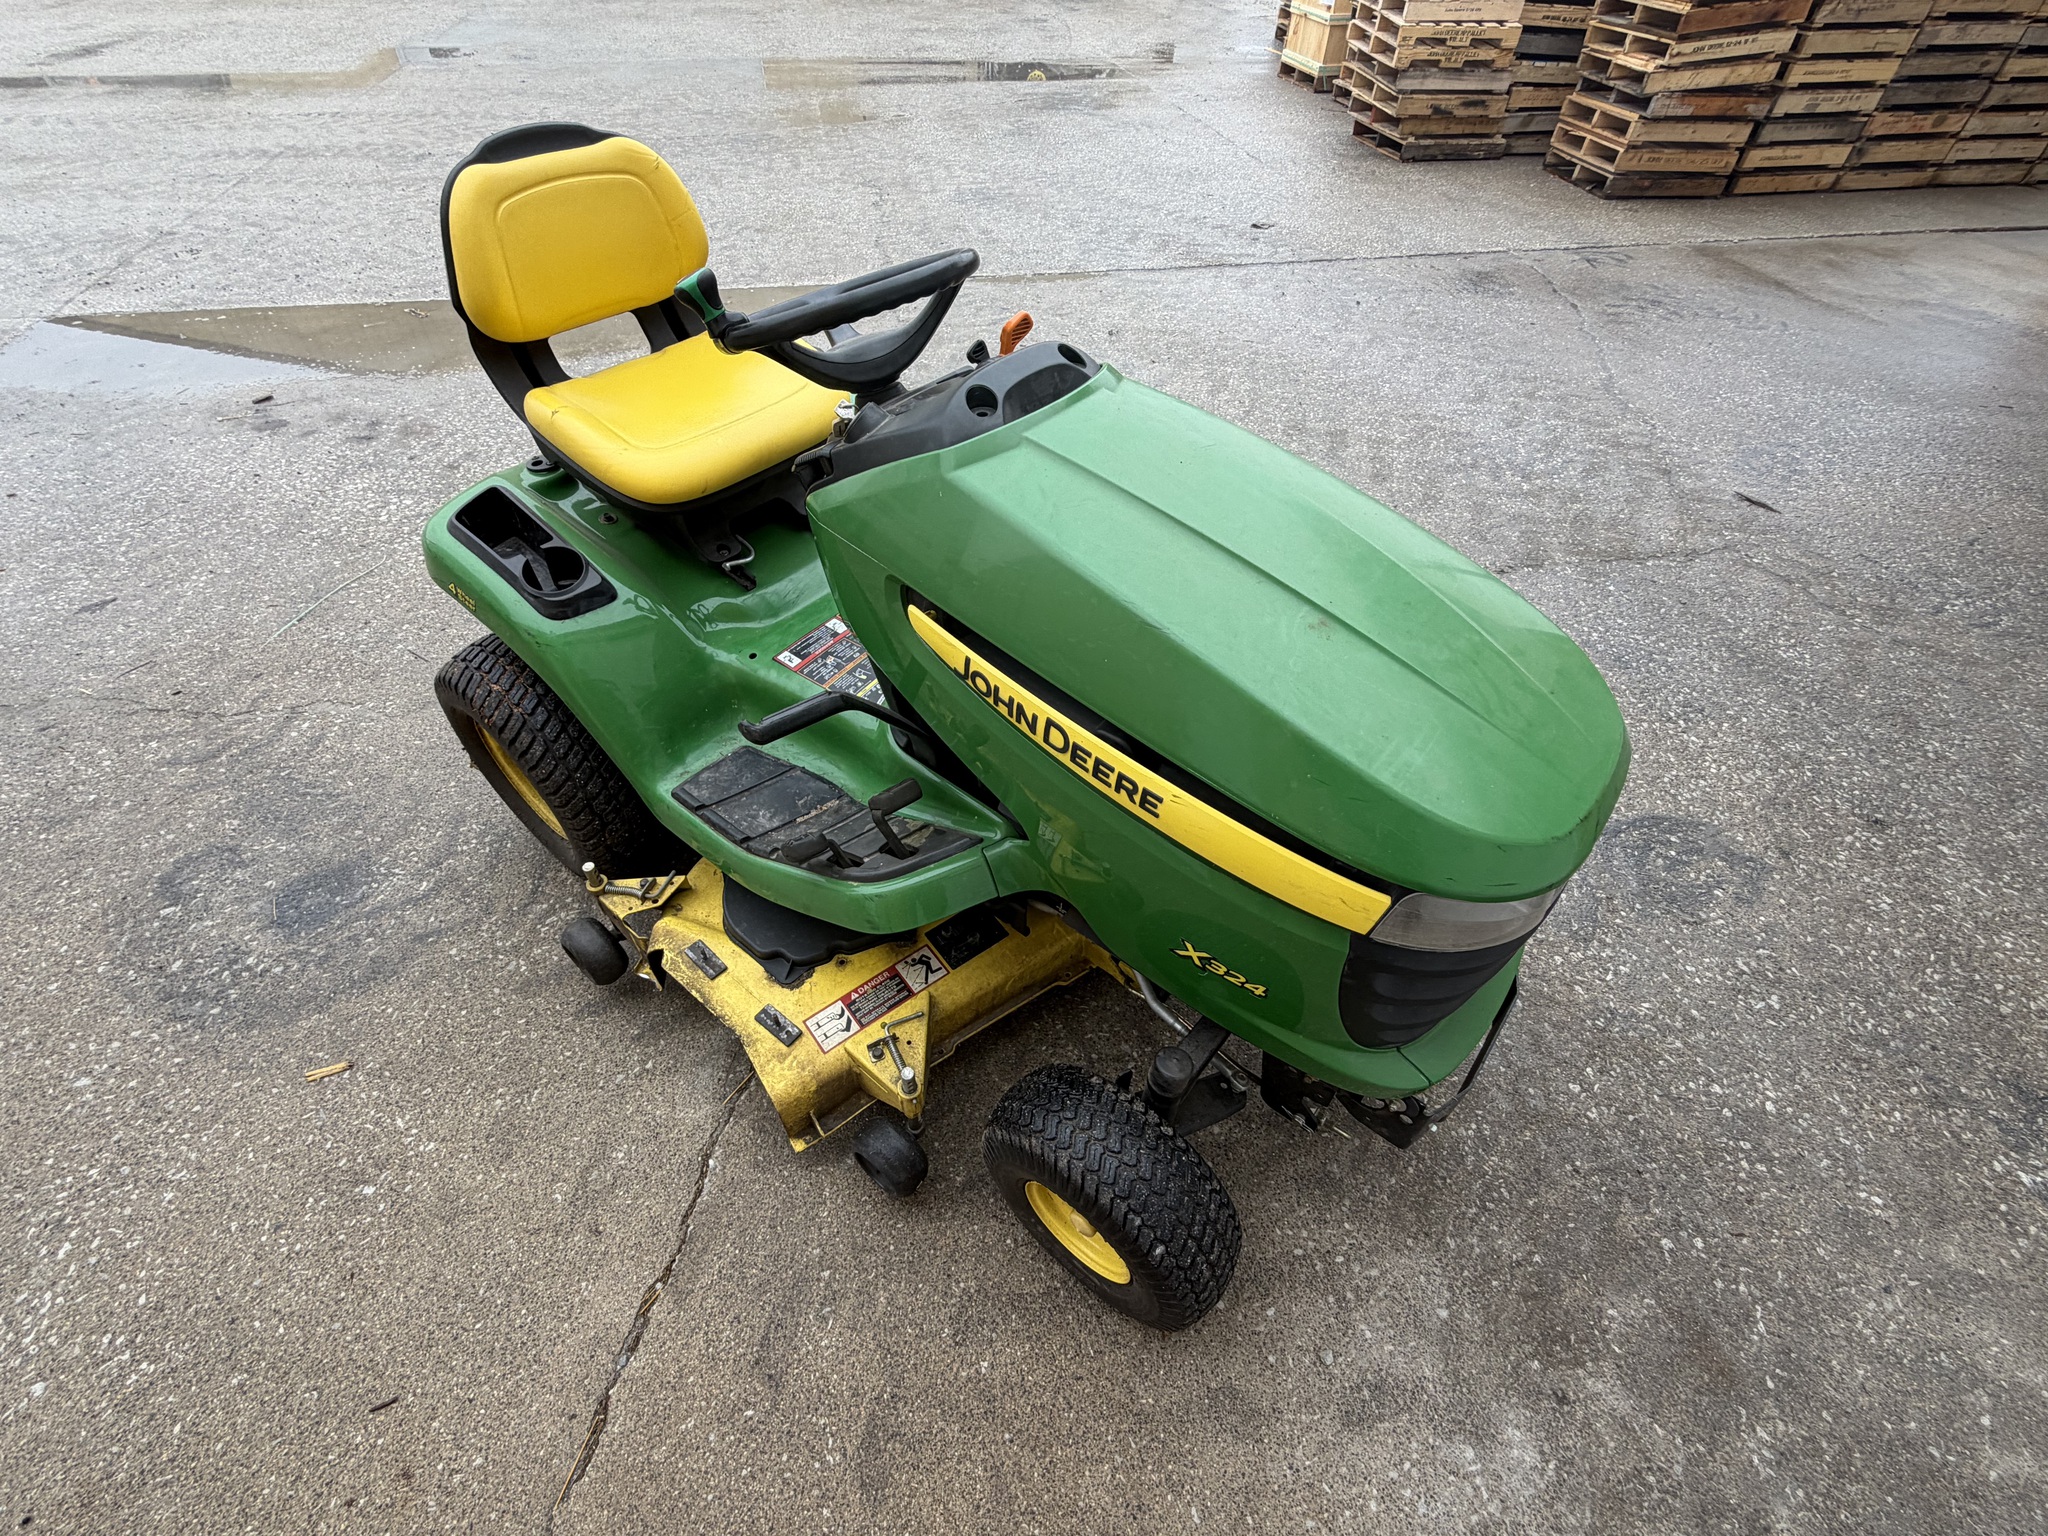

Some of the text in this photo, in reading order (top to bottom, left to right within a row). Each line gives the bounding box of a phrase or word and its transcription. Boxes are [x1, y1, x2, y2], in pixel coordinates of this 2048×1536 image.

[953, 655, 1038, 736] JOHN
[1043, 716, 1164, 818] DEERE
[857, 971, 890, 994] DANGER
[1171, 939, 1268, 998] X324
